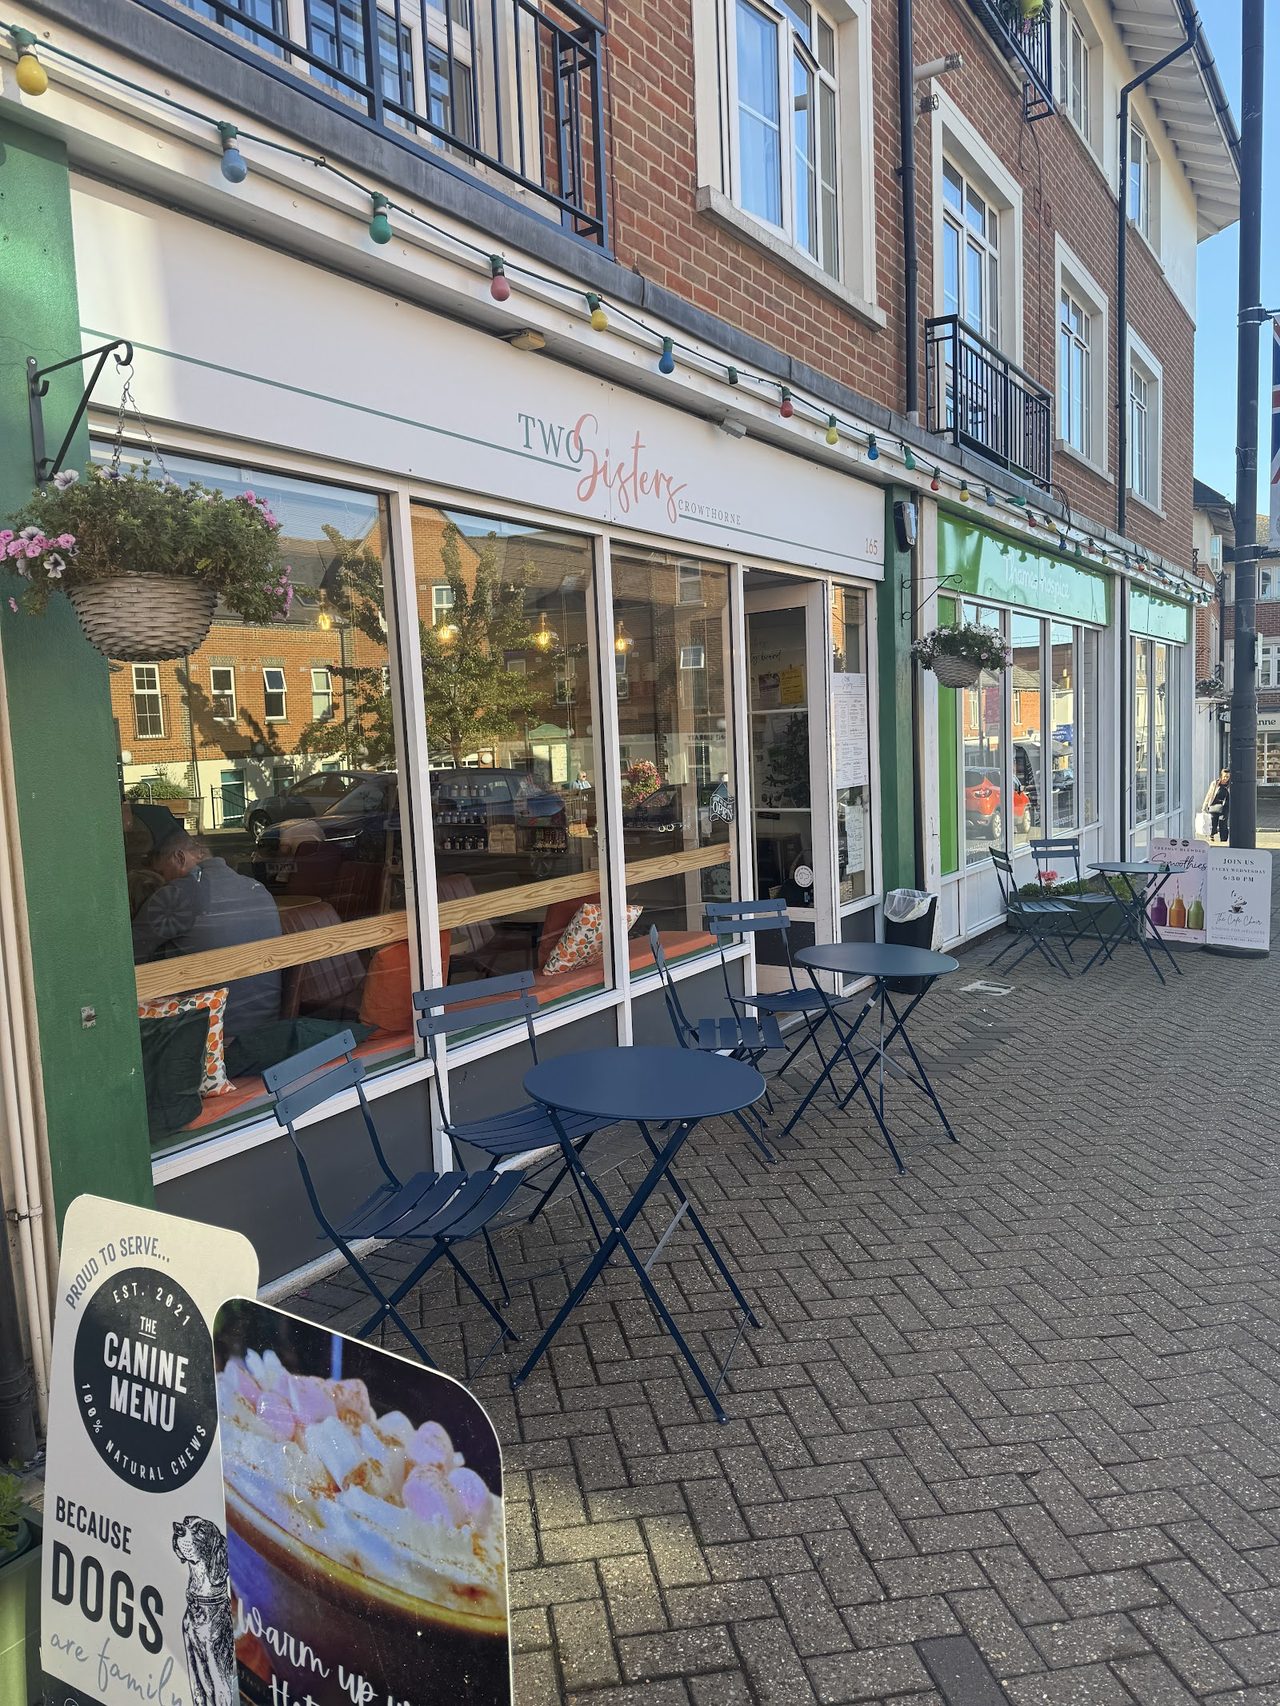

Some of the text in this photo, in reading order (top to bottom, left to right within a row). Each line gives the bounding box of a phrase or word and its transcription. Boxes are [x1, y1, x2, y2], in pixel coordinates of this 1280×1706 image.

[518, 413, 584, 464] TWO
[573, 413, 687, 523] Sisters
[677, 499, 742, 526] CROWTHORNE
[865, 537, 878, 556] 165
[712, 801, 734, 820] OPEN
[1151, 853, 1207, 871] Smoothies
[65, 1235, 171, 1310] PROUD TO SERVE...
[112, 1282, 191, 1326] EST. 2021
[139, 1315, 158, 1335] THE
[103, 1331, 189, 1394] CANINE
[109, 1375, 177, 1433] MENU
[82, 1383, 206, 1481] 100% NATURAL CHEWS
[56, 1495, 132, 1555] BECAUSE
[51, 1540, 164, 1655] DOGS
[50, 1633, 89, 1662] are
[338, 1664, 378, 1706] up
